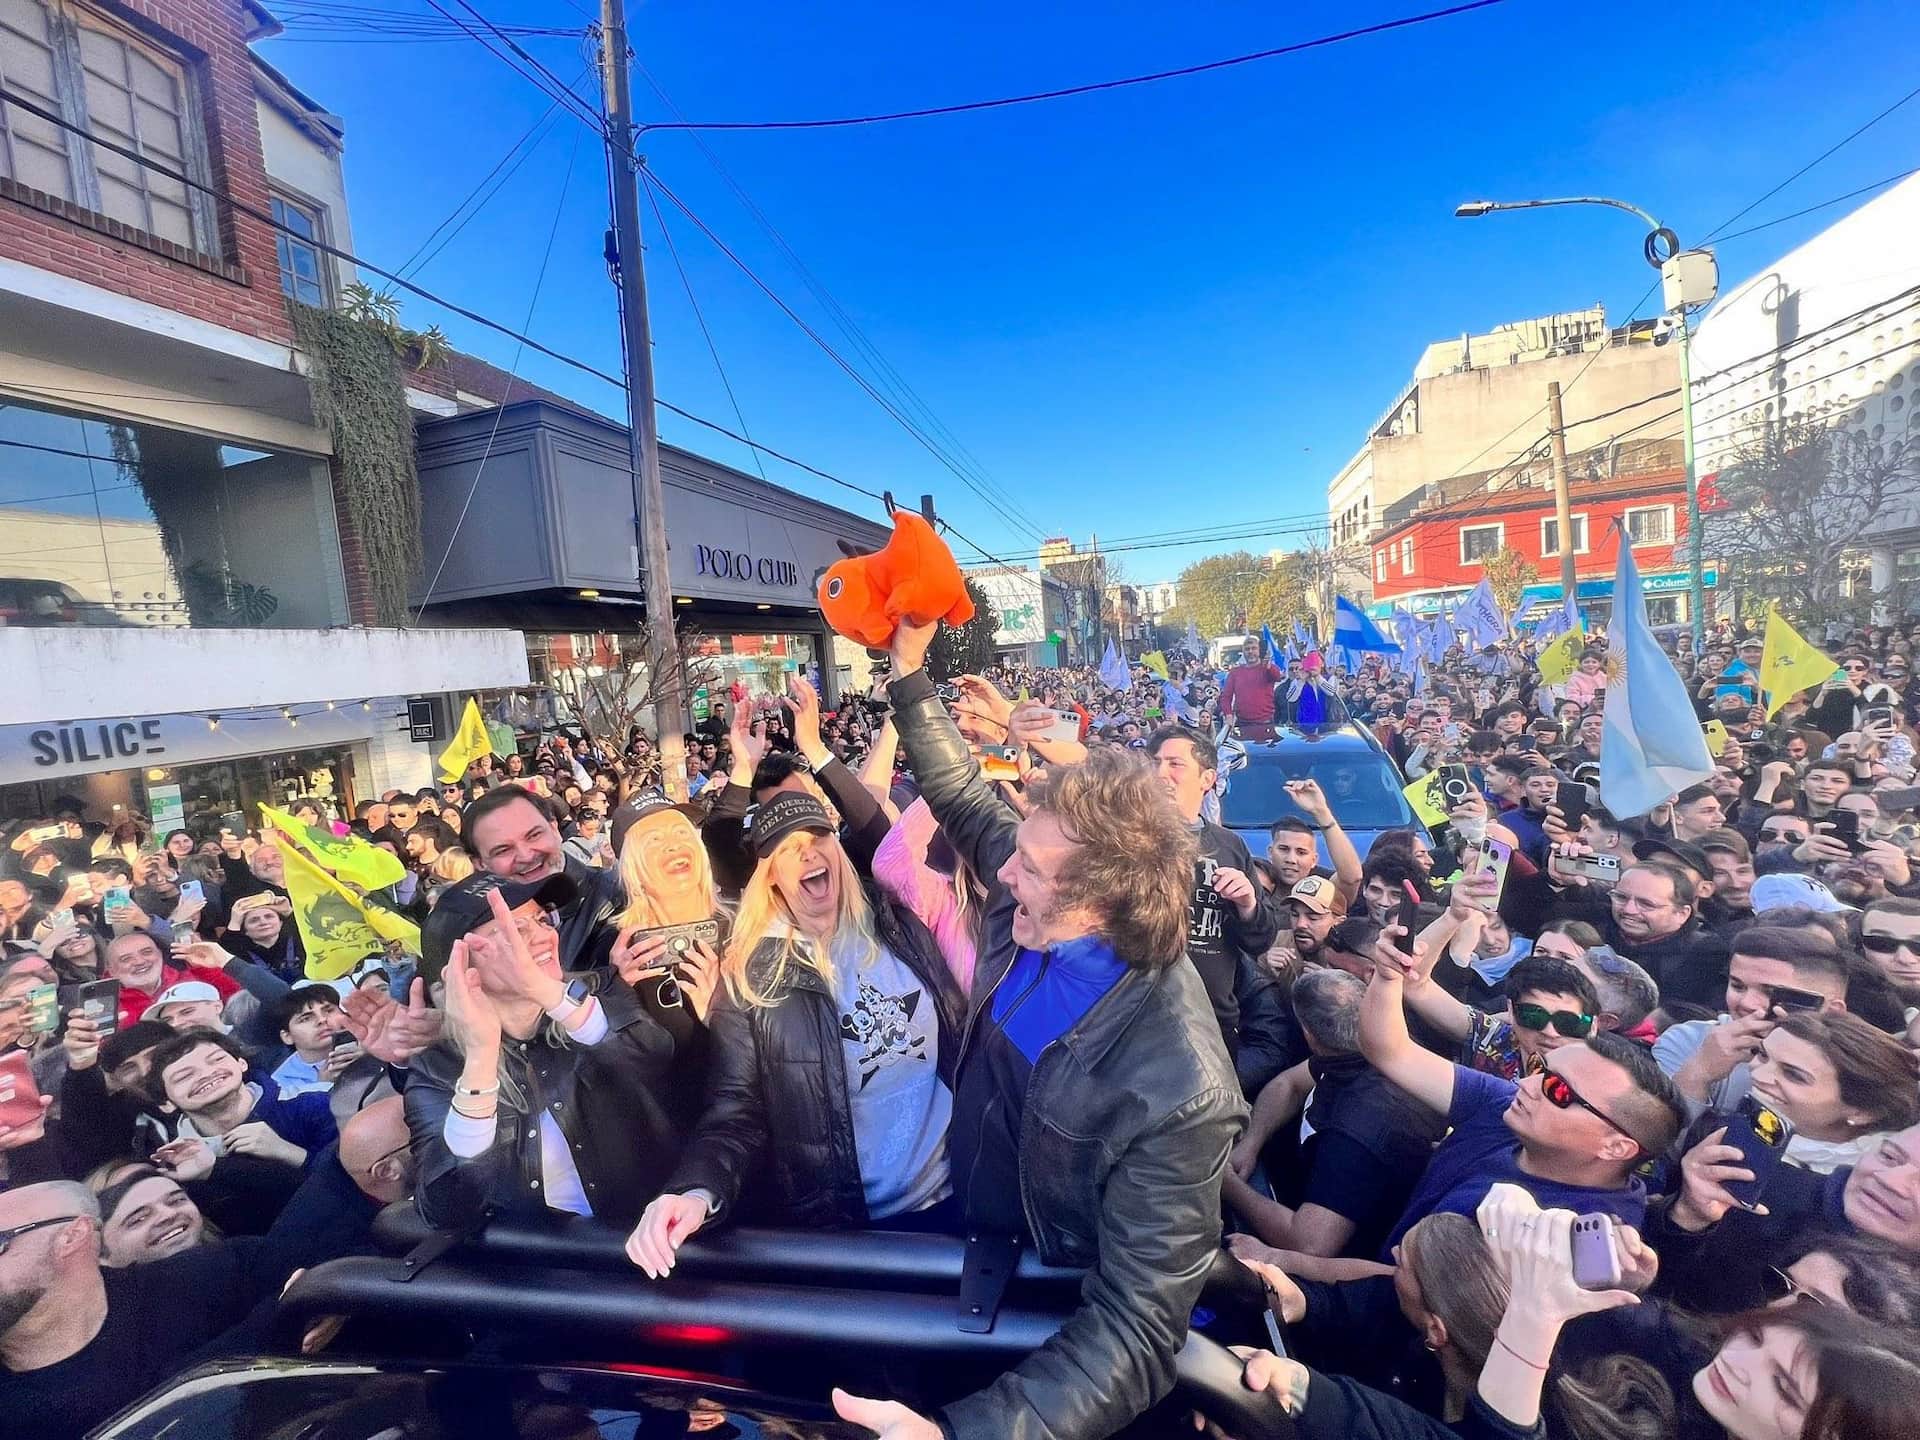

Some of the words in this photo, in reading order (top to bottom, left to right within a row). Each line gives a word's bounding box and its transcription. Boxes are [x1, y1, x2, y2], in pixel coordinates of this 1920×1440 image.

[697, 544, 752, 581] POLO
[758, 558, 797, 586] CLUB
[31, 719, 166, 766] SILICE
[760, 815, 783, 834] DEL
[785, 806, 823, 816] CIELO
